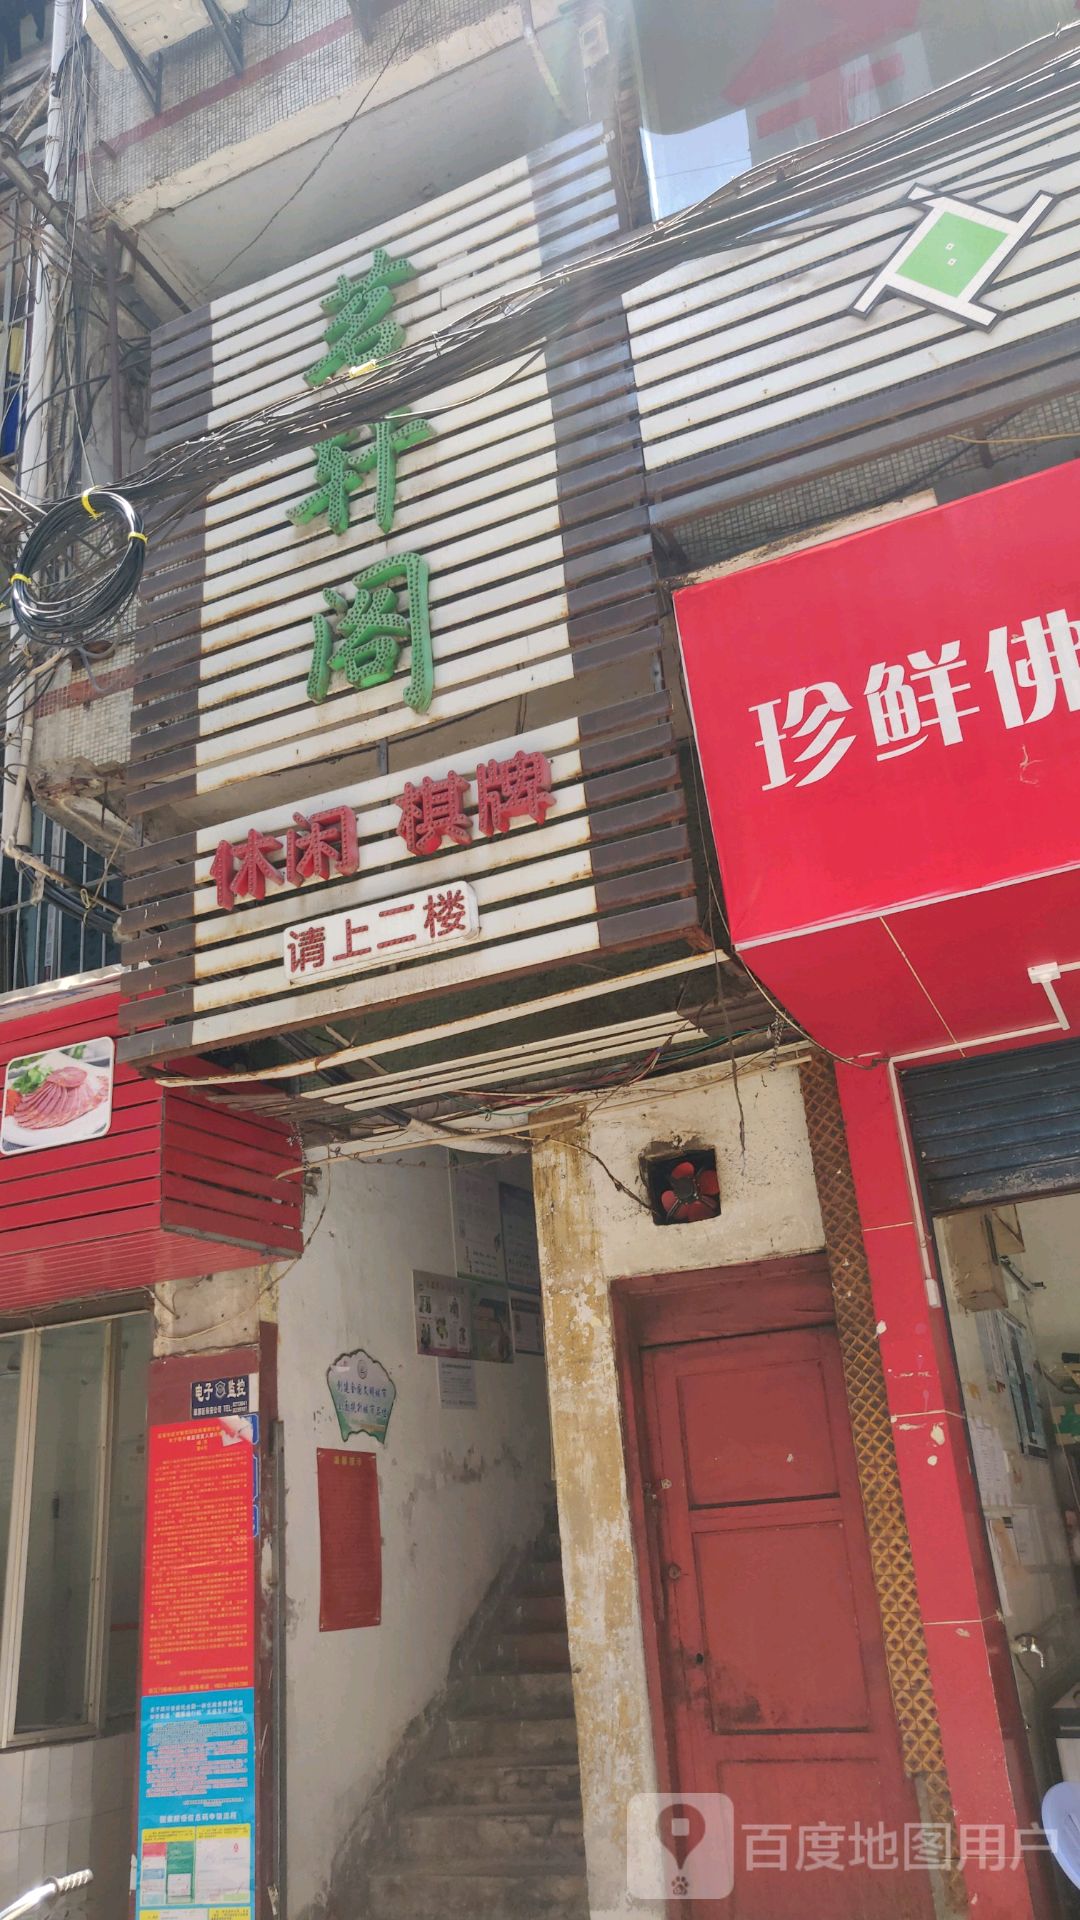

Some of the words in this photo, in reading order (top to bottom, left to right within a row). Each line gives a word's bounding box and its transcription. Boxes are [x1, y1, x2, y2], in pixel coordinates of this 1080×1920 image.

[748, 608, 1080, 791] 珍鲜佛
[211, 804, 360, 912] 休闲
[394, 749, 557, 857] 棋牌
[286, 888, 468, 975] 请上二楼
[195, 1382, 214, 1402] 电子
[227, 1378, 246, 1399] 监控
